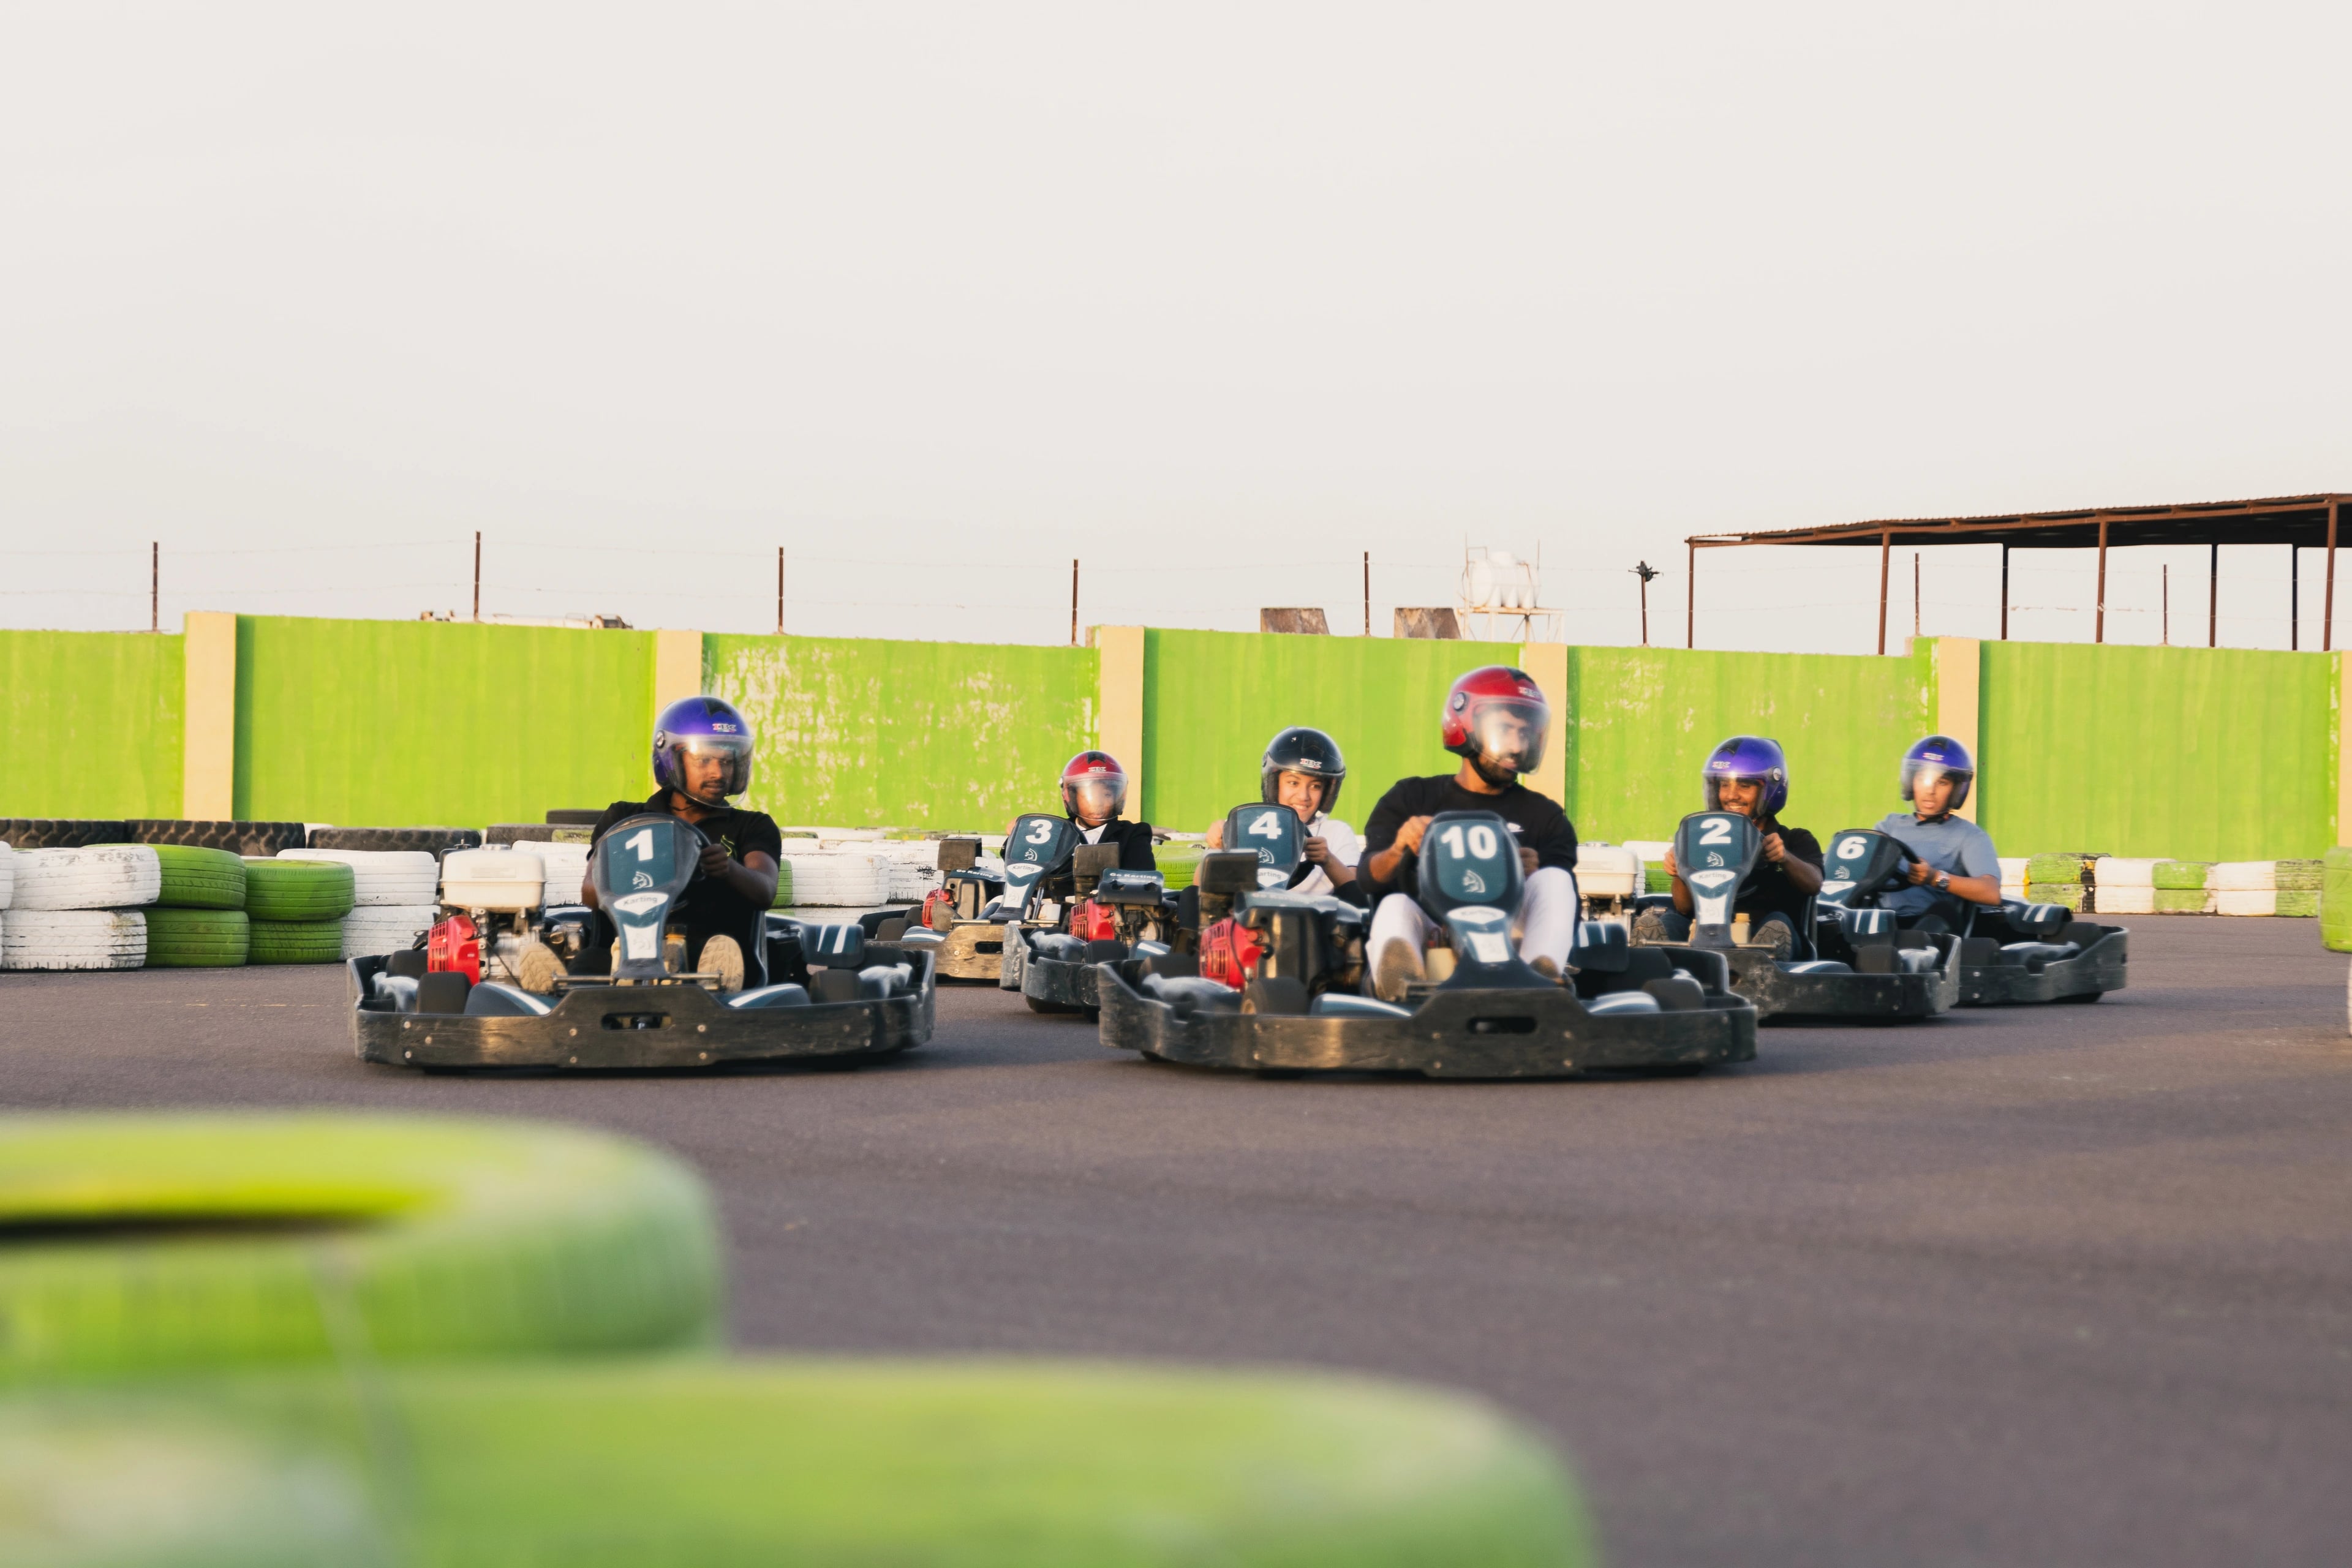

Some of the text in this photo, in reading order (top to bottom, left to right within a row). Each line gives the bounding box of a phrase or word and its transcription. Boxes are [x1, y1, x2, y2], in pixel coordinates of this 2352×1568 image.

[1025, 819, 1052, 843] 3
[1249, 812, 1281, 839] 4
[1699, 818, 1731, 845] 2
[625, 828, 654, 861] 1
[1441, 825, 1497, 859] 10
[1836, 836, 1867, 859] 6
[624, 897, 657, 906] Karting
